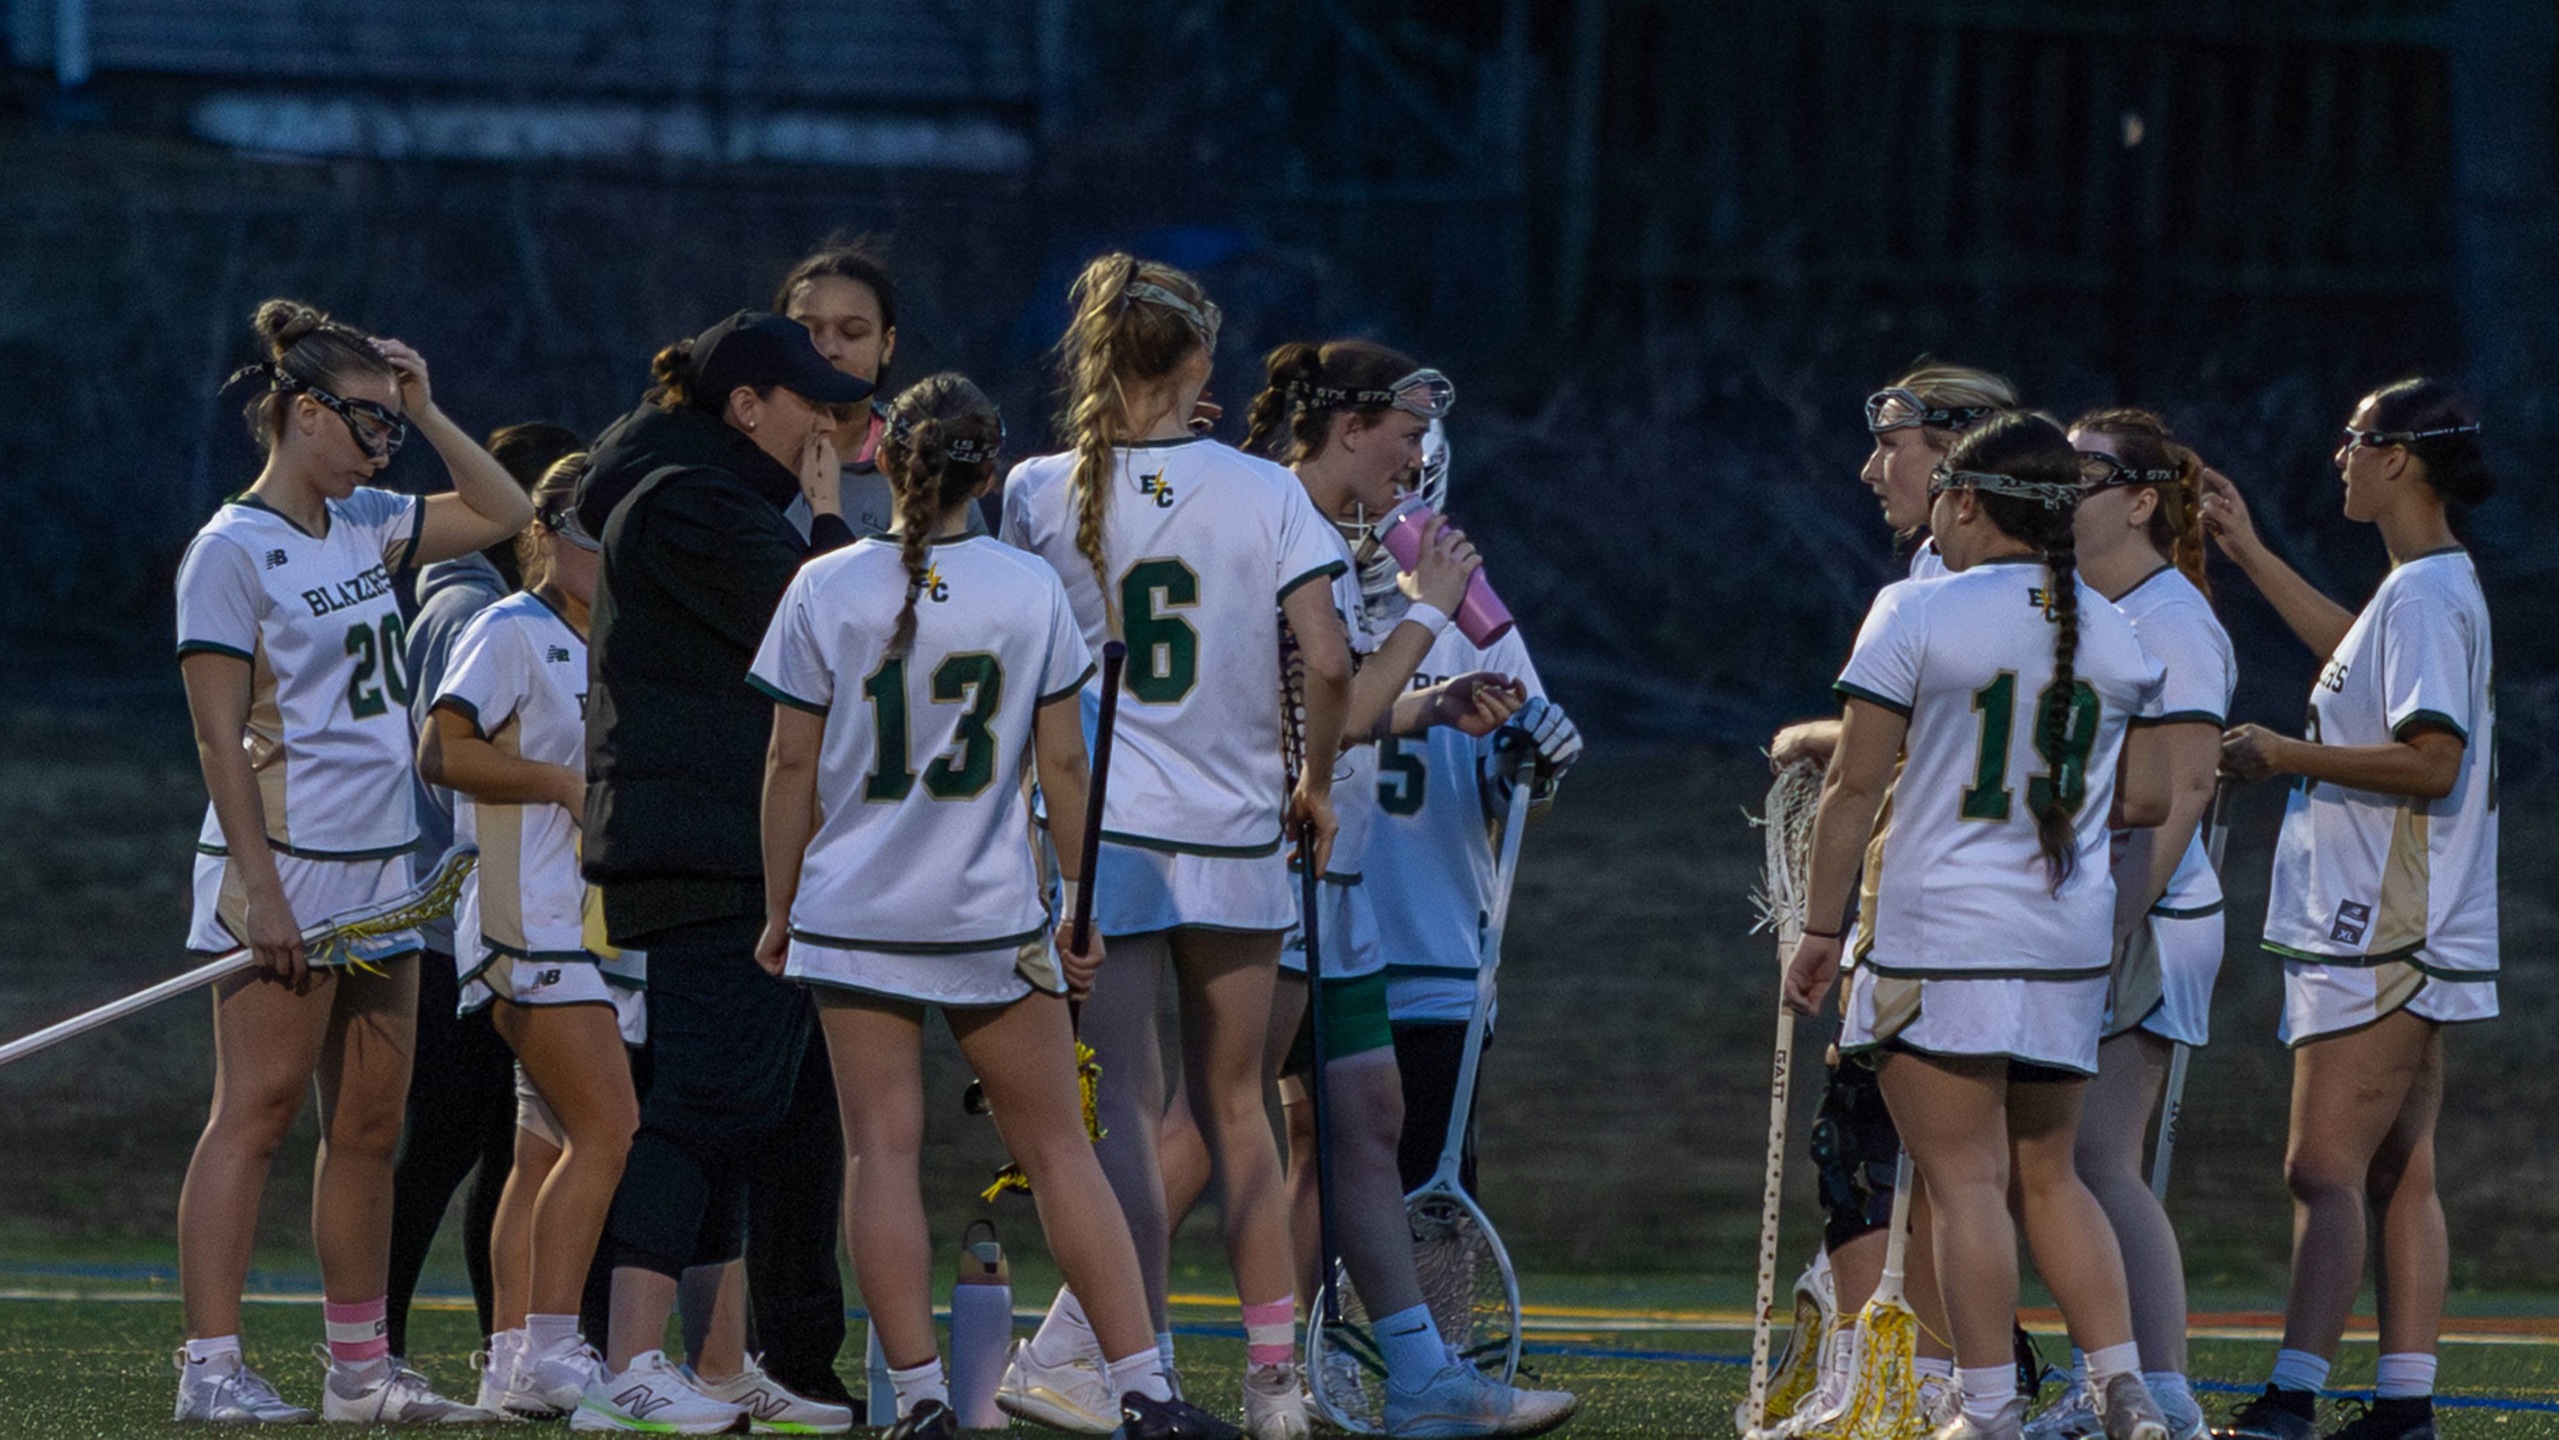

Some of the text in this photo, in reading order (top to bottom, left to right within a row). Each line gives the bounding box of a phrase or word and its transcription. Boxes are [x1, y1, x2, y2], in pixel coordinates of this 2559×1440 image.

[1357, 390, 1391, 402] STX
[344, 611, 410, 721] 20
[1116, 554, 1201, 706] 6
[862, 650, 1006, 804] 13
[1956, 666, 2101, 832] 19
[1774, 1049, 1787, 1103] GATT
